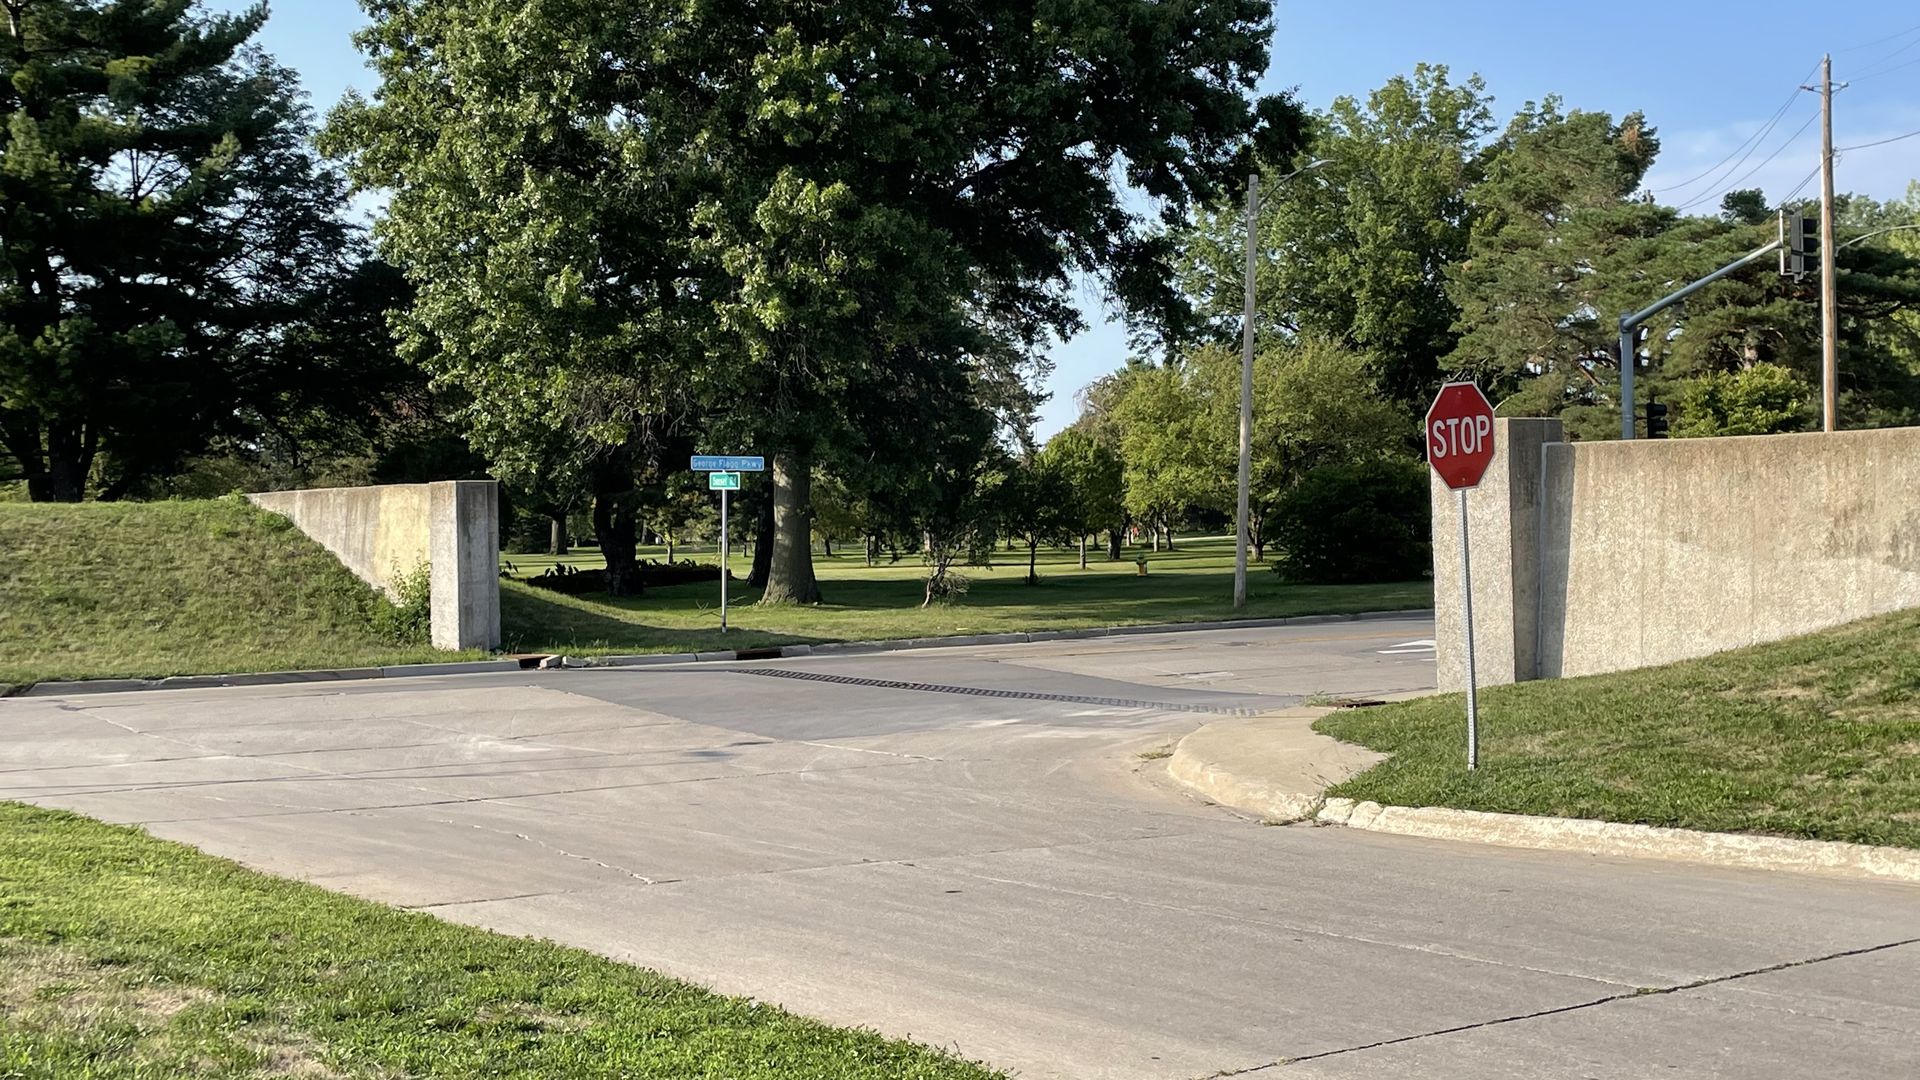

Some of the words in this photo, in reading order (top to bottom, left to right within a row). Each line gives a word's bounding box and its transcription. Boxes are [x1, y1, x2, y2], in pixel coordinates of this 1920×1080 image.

[1432, 415, 1490, 458] STOP
[693, 459, 716, 469] George
[719, 459, 739, 469] Flagg
[742, 459, 762, 469] Pkwy
